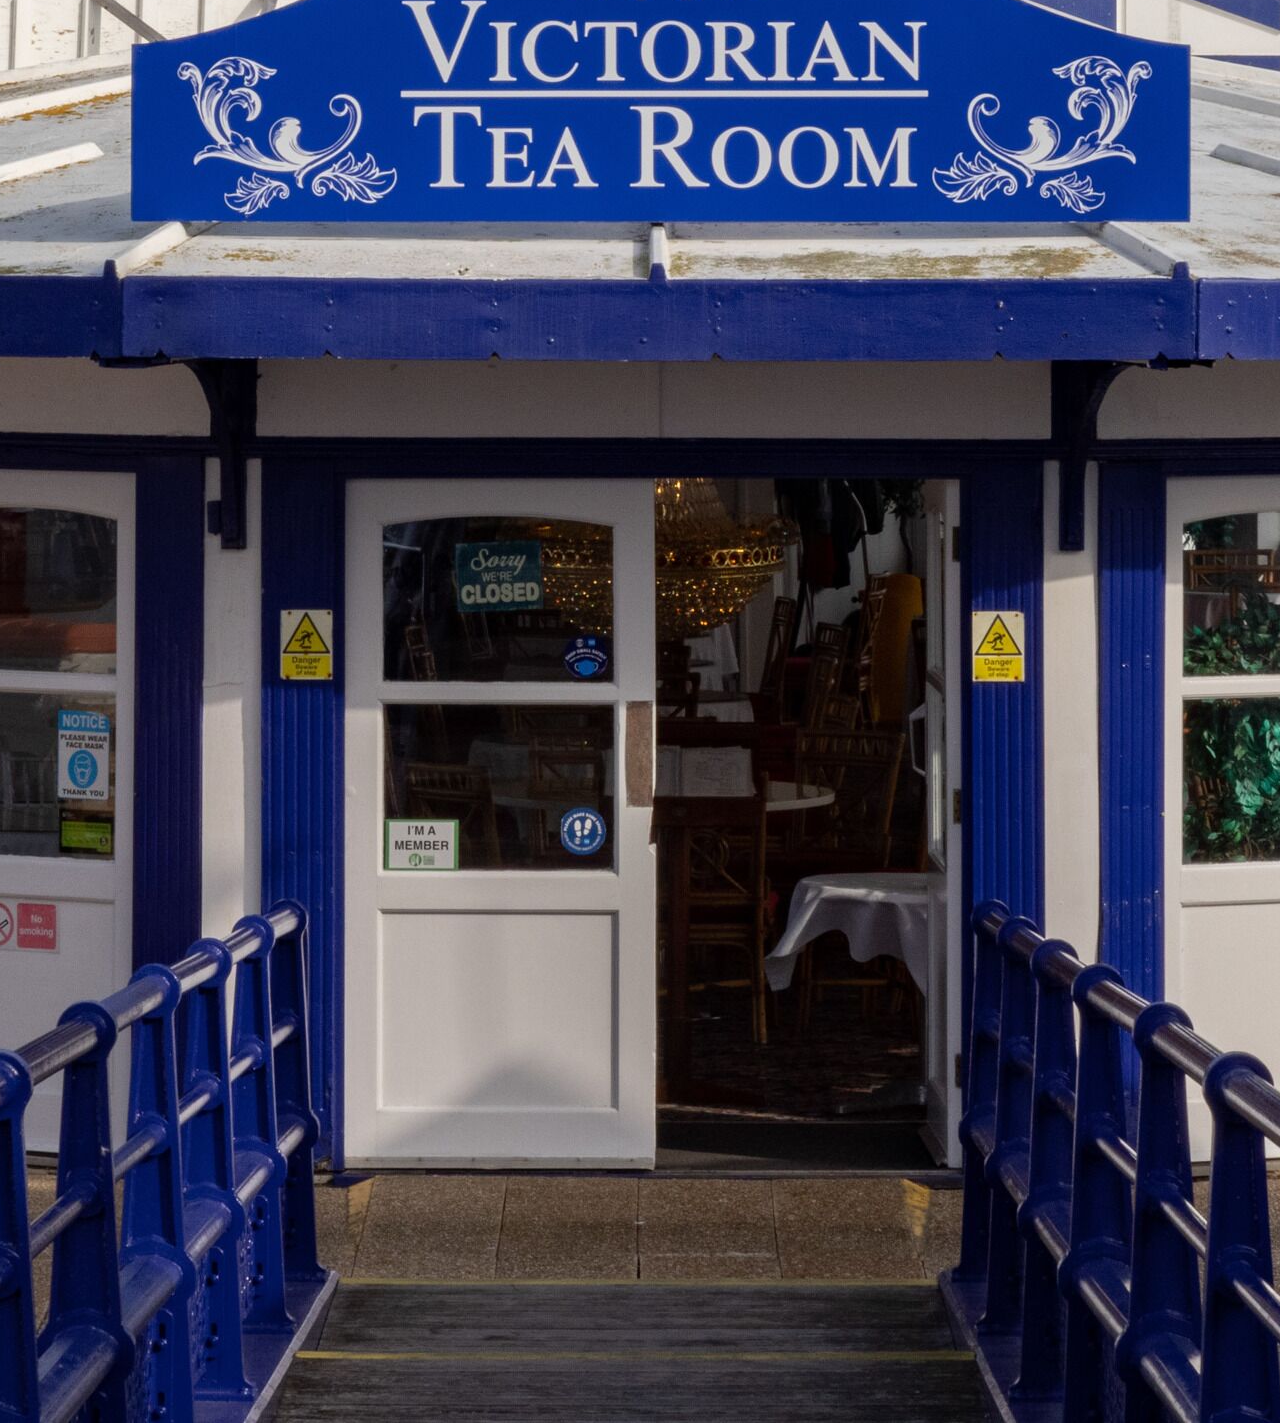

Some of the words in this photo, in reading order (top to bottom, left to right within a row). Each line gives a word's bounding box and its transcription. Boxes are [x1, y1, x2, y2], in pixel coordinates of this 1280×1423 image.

[402, 0, 927, 84] VICTORIAN
[413, 105, 598, 189] TEA
[629, 104, 917, 190] ROOM
[470, 548, 526, 576] Sorry
[481, 571, 513, 582] WE'RE
[461, 582, 540, 605] CLOSED
[62, 714, 107, 729] NOTICE
[85, 742, 104, 750] MASK
[63, 788, 87, 796] THANK
[90, 789, 105, 797] YOU
[408, 825, 424, 835] I'M
[427, 826, 436, 835] A
[394, 840, 449, 850] MEMBER
[31, 914, 43, 923] No
[19, 928, 54, 939] smoking
